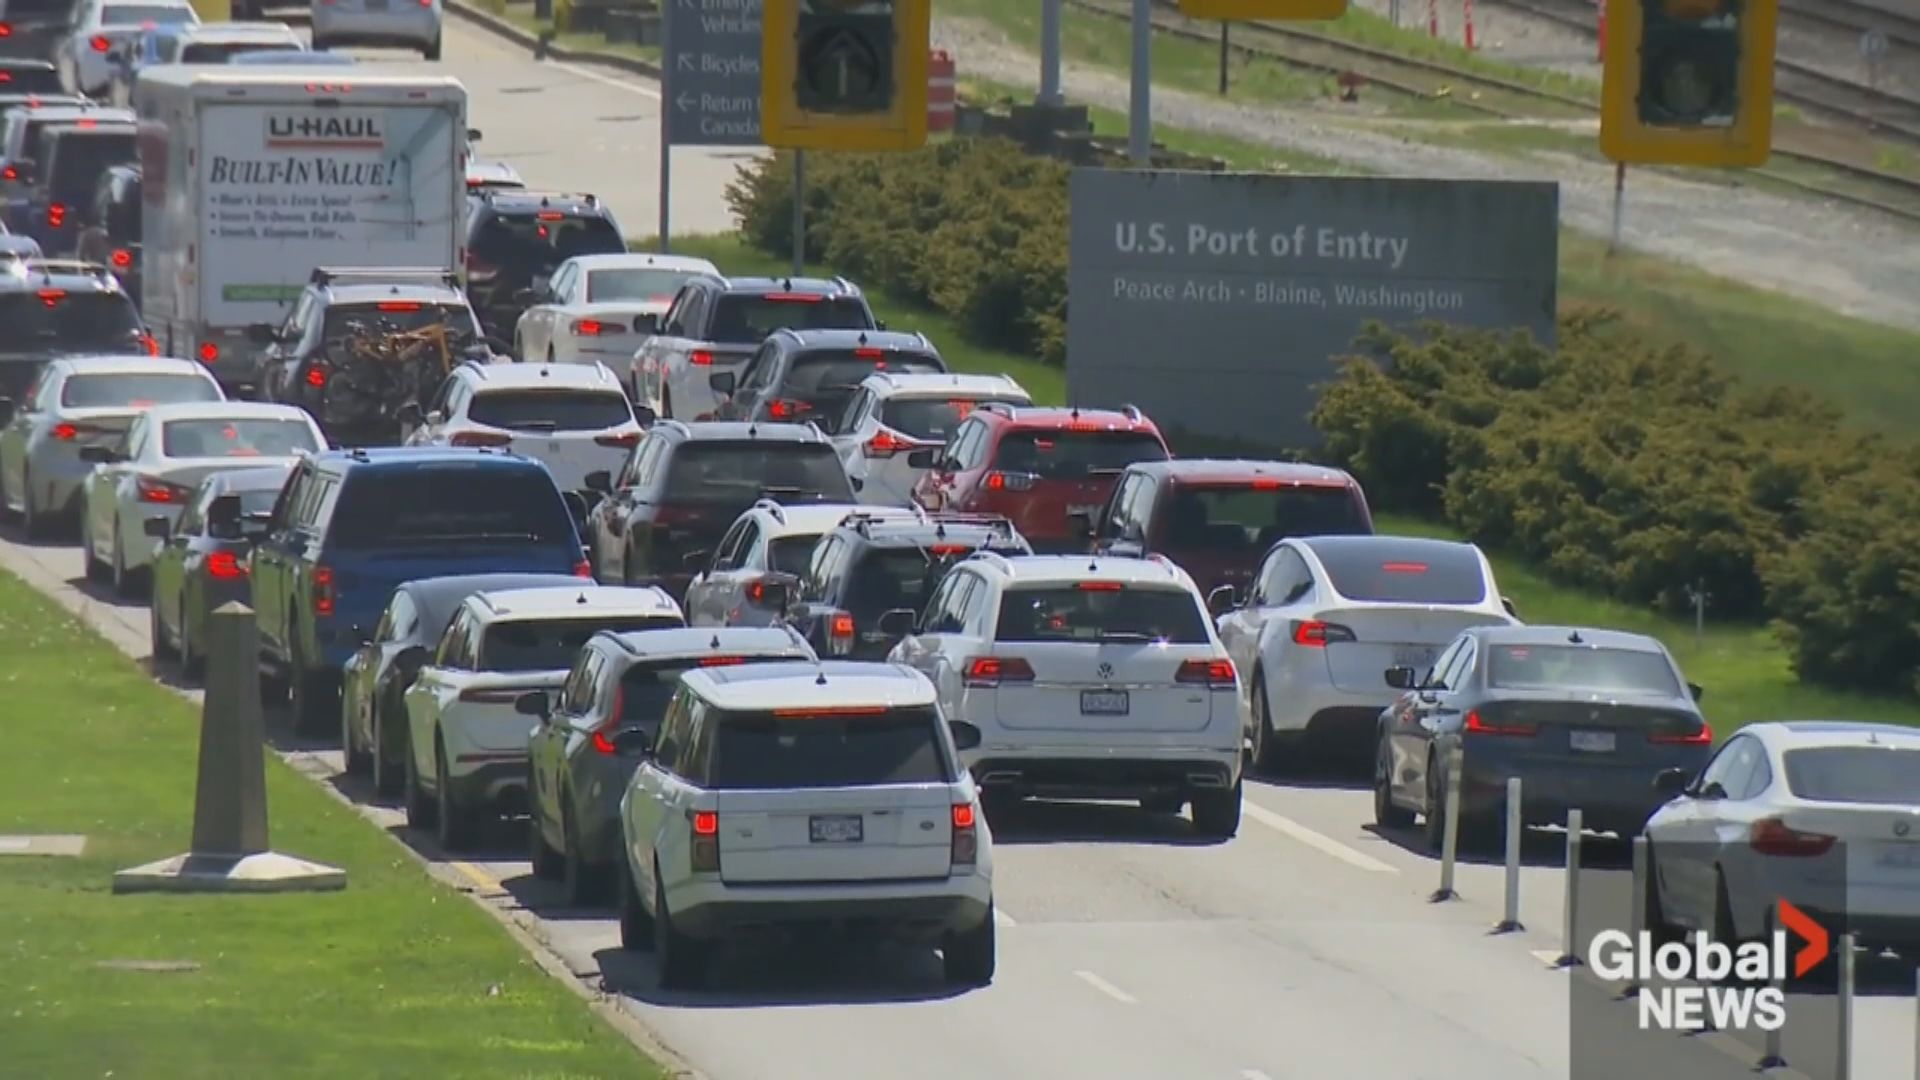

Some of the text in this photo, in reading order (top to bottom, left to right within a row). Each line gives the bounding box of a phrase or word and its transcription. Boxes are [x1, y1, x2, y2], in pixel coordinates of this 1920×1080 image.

[701, 54, 760, 77] Bicycles
[701, 94, 753, 111] Return
[210, 156, 398, 186] BUILT-IN VALUE!
[1115, 222, 1409, 270] U.S. Port of Entry
[1114, 278, 1463, 314] Peace Arch Blaine, Washington
